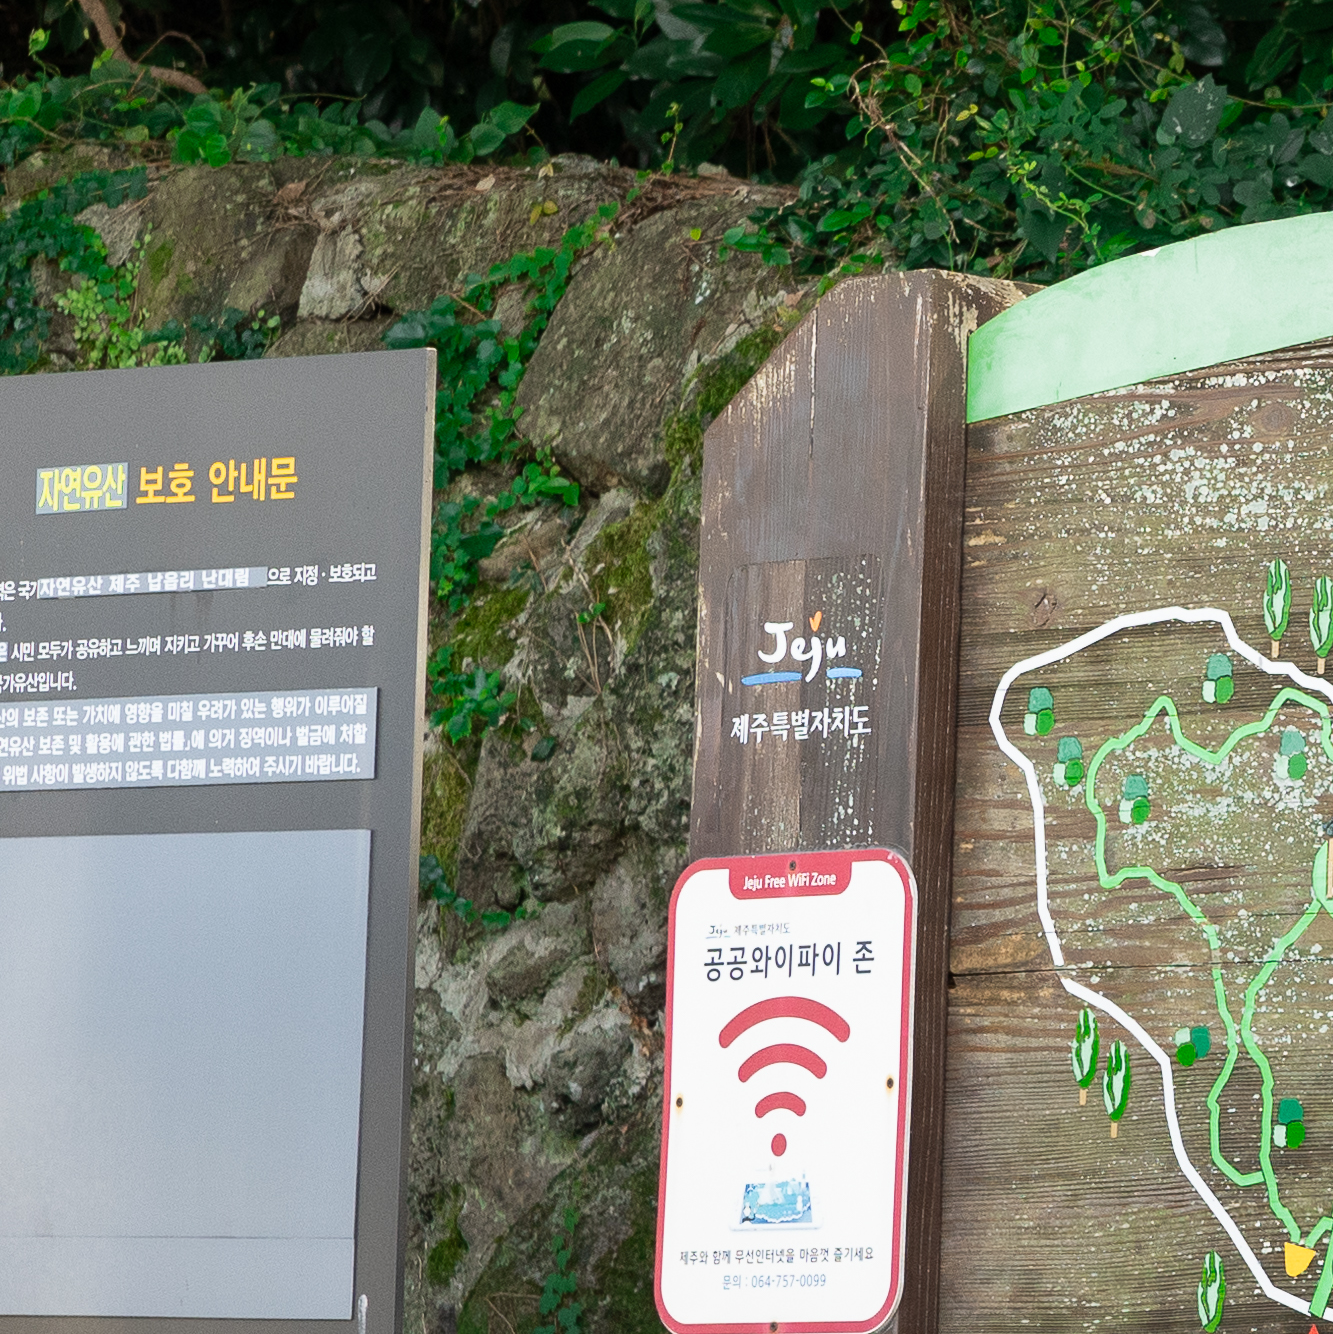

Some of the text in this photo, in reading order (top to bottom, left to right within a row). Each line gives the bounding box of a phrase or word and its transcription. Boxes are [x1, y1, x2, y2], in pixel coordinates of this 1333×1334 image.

[39, 457, 298, 511] 자연유산 보호 안내문
[109, 574, 140, 593] 제주
[148, 571, 195, 591] 납읍리
[202, 568, 249, 588] 난대림
[268, 567, 292, 585] 으로
[329, 563, 377, 583] 보호되고
[11, 641, 34, 662] 시민
[37, 639, 73, 660] 모두가
[76, 637, 123, 660] 공유하고
[125, 635, 161, 656] 느끼며
[164, 633, 200, 655] 지키고
[204, 632, 239, 653] 가꾸어
[242, 630, 267, 651] 후손
[270, 628, 307, 650] 만대에
[310, 626, 359, 648] 물려줘야
[361, 625, 375, 646] 할
[757, 611, 847, 683] Jeju
[23, 694, 367, 727] 보존 또는 가치에 영향을 미칠 우려가 있는 행위가 이루어질
[731, 705, 872, 746] 제주특별자치도
[39, 735, 65, 756] 보존
[69, 733, 82, 755] 및
[85, 732, 124, 754] 활용에
[128, 731, 154, 752] 관한
[208, 728, 235, 748] 의거
[239, 725, 292, 748] 징역이나
[295, 724, 336, 746] 벌금에
[340, 723, 367, 744] 처할
[3, 753, 361, 785] 위법 사항이 발생하지 않도록 다함께 노력하여 주시기 바랍니다.
[743, 872, 837, 891] Jeju Free WiFi Zone
[704, 940, 875, 982] 공공와이파이 존
[680, 1246, 874, 1265] 제주와 함께 무선인터넷을 마음껏 즐기세요
[751, 1273, 827, 1288] 064-757-0099
